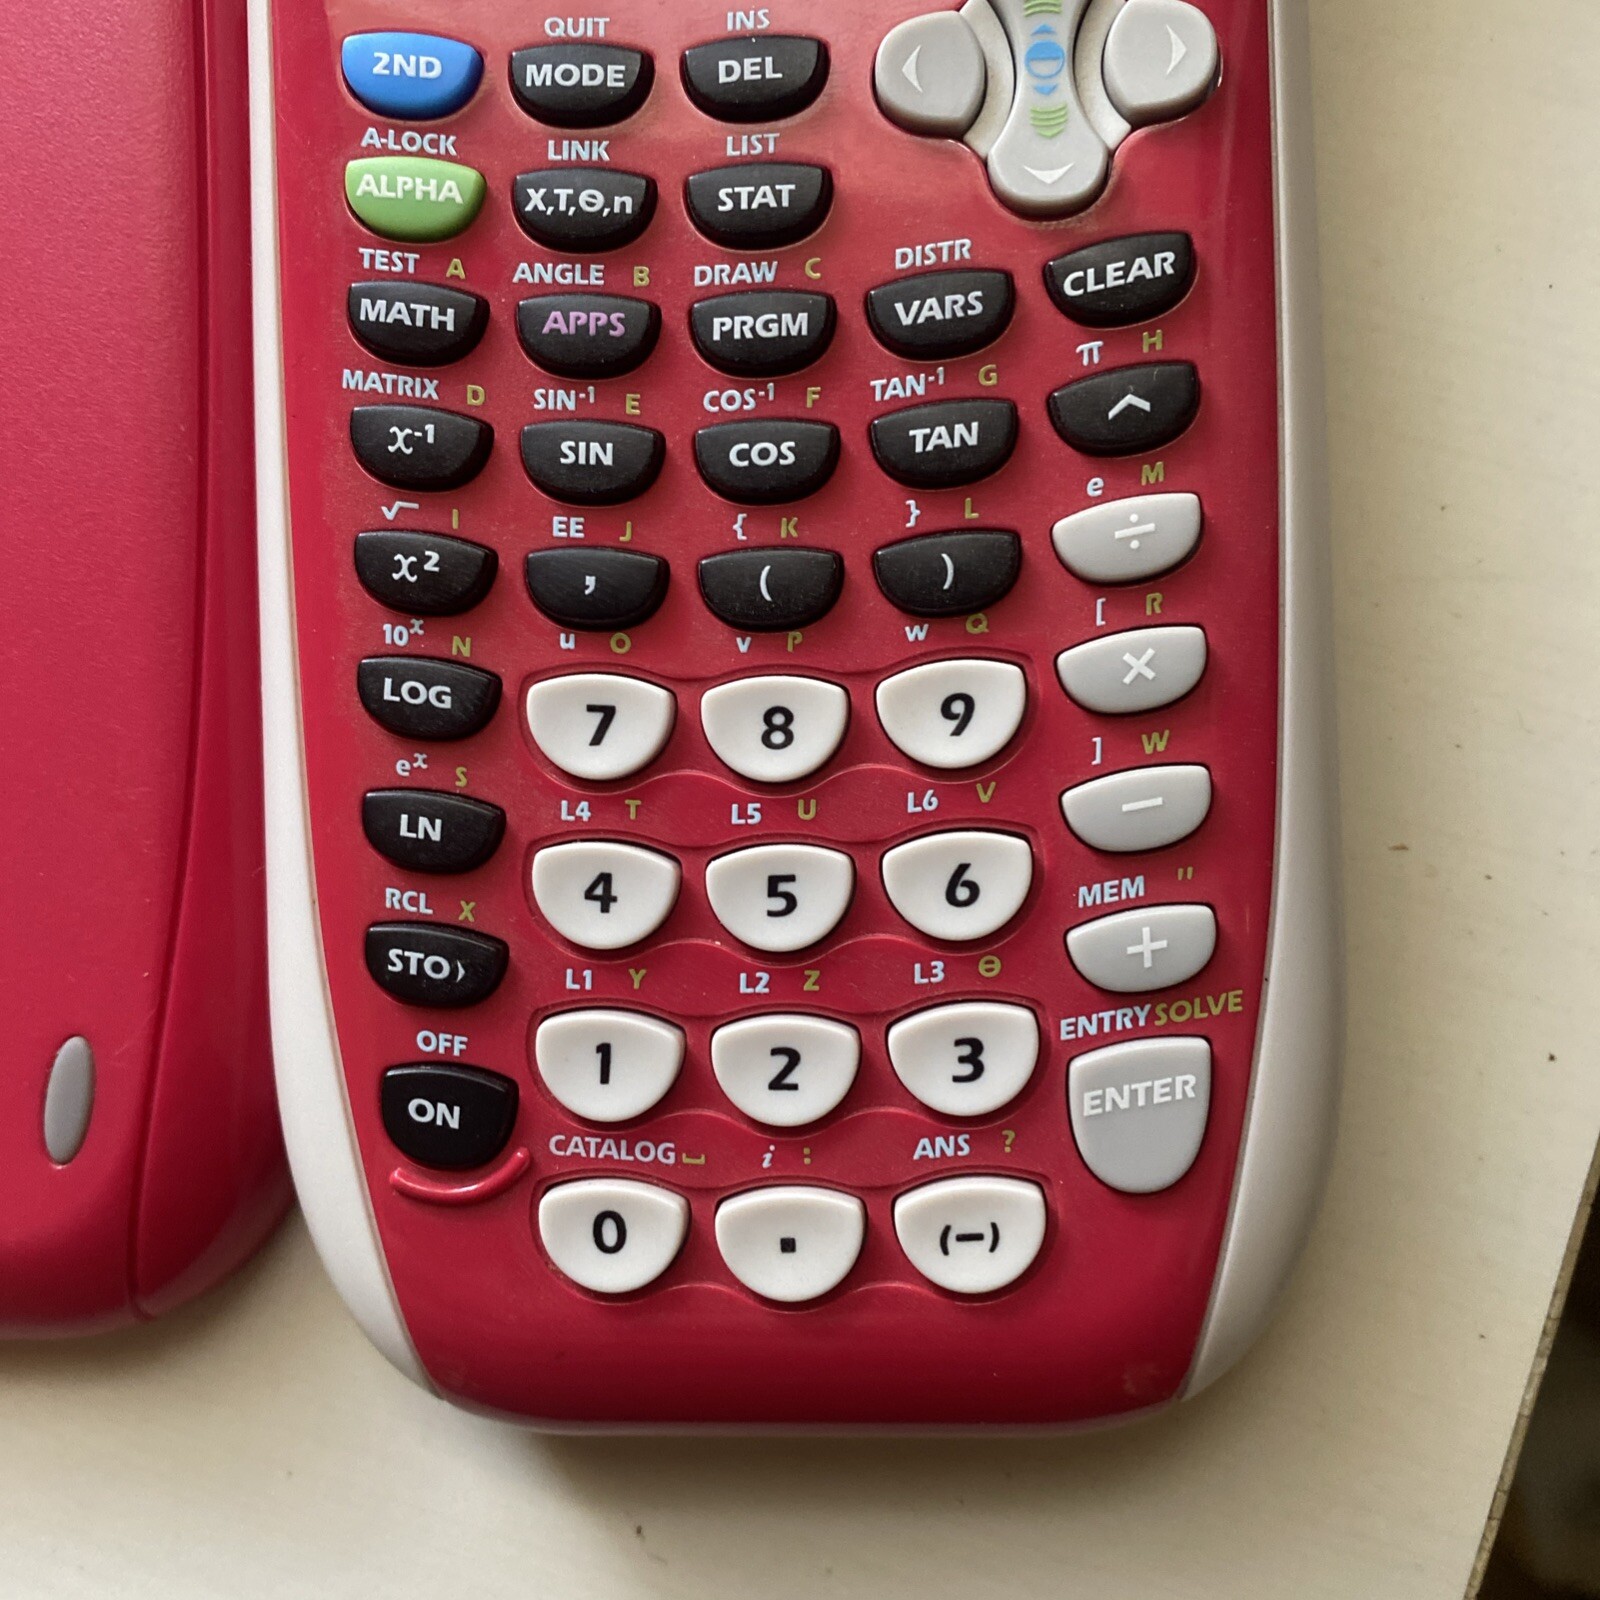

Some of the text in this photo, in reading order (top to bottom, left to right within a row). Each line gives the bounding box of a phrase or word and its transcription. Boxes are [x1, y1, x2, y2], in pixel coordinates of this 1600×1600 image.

[544, 17, 610, 37] QUIT
[727, 10, 770, 30] INS
[373, 52, 442, 79] 2ND
[525, 64, 625, 88] MODE
[718, 58, 782, 83] DEL
[361, 129, 458, 155] A-LOCK
[547, 140, 610, 161] LINK
[726, 134, 780, 155] LIST
[356, 174, 464, 204] ALPHA
[718, 184, 796, 212] STAT
[358, 248, 466, 279] TEST A
[895, 239, 972, 269] DISTR
[512, 263, 649, 287] ANGLE B
[694, 259, 821, 285] DRAW C
[1063, 251, 1175, 297] CLEAR
[359, 299, 455, 332] MATH
[894, 291, 983, 325] VARS
[541, 311, 625, 337] APPS
[712, 313, 809, 341] PRGM
[1142, 330, 1163, 352] H
[342, 370, 486, 406] MATRIX D
[978, 364, 998, 387] G
[625, 394, 641, 414] E
[806, 387, 822, 408] F
[909, 421, 980, 453] TAN
[560, 441, 614, 466] SIN
[729, 441, 797, 467] COS
[1087, 462, 1165, 497] e M
[964, 498, 979, 519] L
[552, 517, 632, 541] EE J
[781, 517, 799, 538] K
[1146, 593, 1162, 615] R
[966, 613, 989, 634] Q
[452, 636, 471, 657] N
[787, 632, 803, 652] P
[383, 678, 452, 710] LOG
[585, 705, 617, 747] 7
[940, 692, 976, 737] 9
[760, 706, 795, 750] 8
[1141, 730, 1170, 754] W
[455, 766, 468, 787] S
[976, 781, 996, 803] V
[625, 800, 642, 820] T
[797, 799, 817, 821] U
[399, 814, 442, 842] LN
[584, 872, 618, 913] 4
[766, 874, 797, 917] 5
[945, 862, 981, 908] 6
[1078, 875, 1145, 908] MEM
[385, 888, 476, 921] RCL X
[629, 968, 648, 990] Y
[803, 970, 820, 992] Z
[1060, 989, 1244, 1041] ENTRY SOLVE
[416, 1030, 468, 1056] OFF
[595, 1043, 612, 1085] 1
[768, 1047, 801, 1092] 2
[951, 1037, 985, 1084] 3
[1083, 1074, 1197, 1118] ENTER
[408, 1099, 461, 1129] ON
[548, 1135, 675, 1165] CATALOG
[913, 1134, 971, 1160] ANS
[592, 1210, 627, 1254] 0
